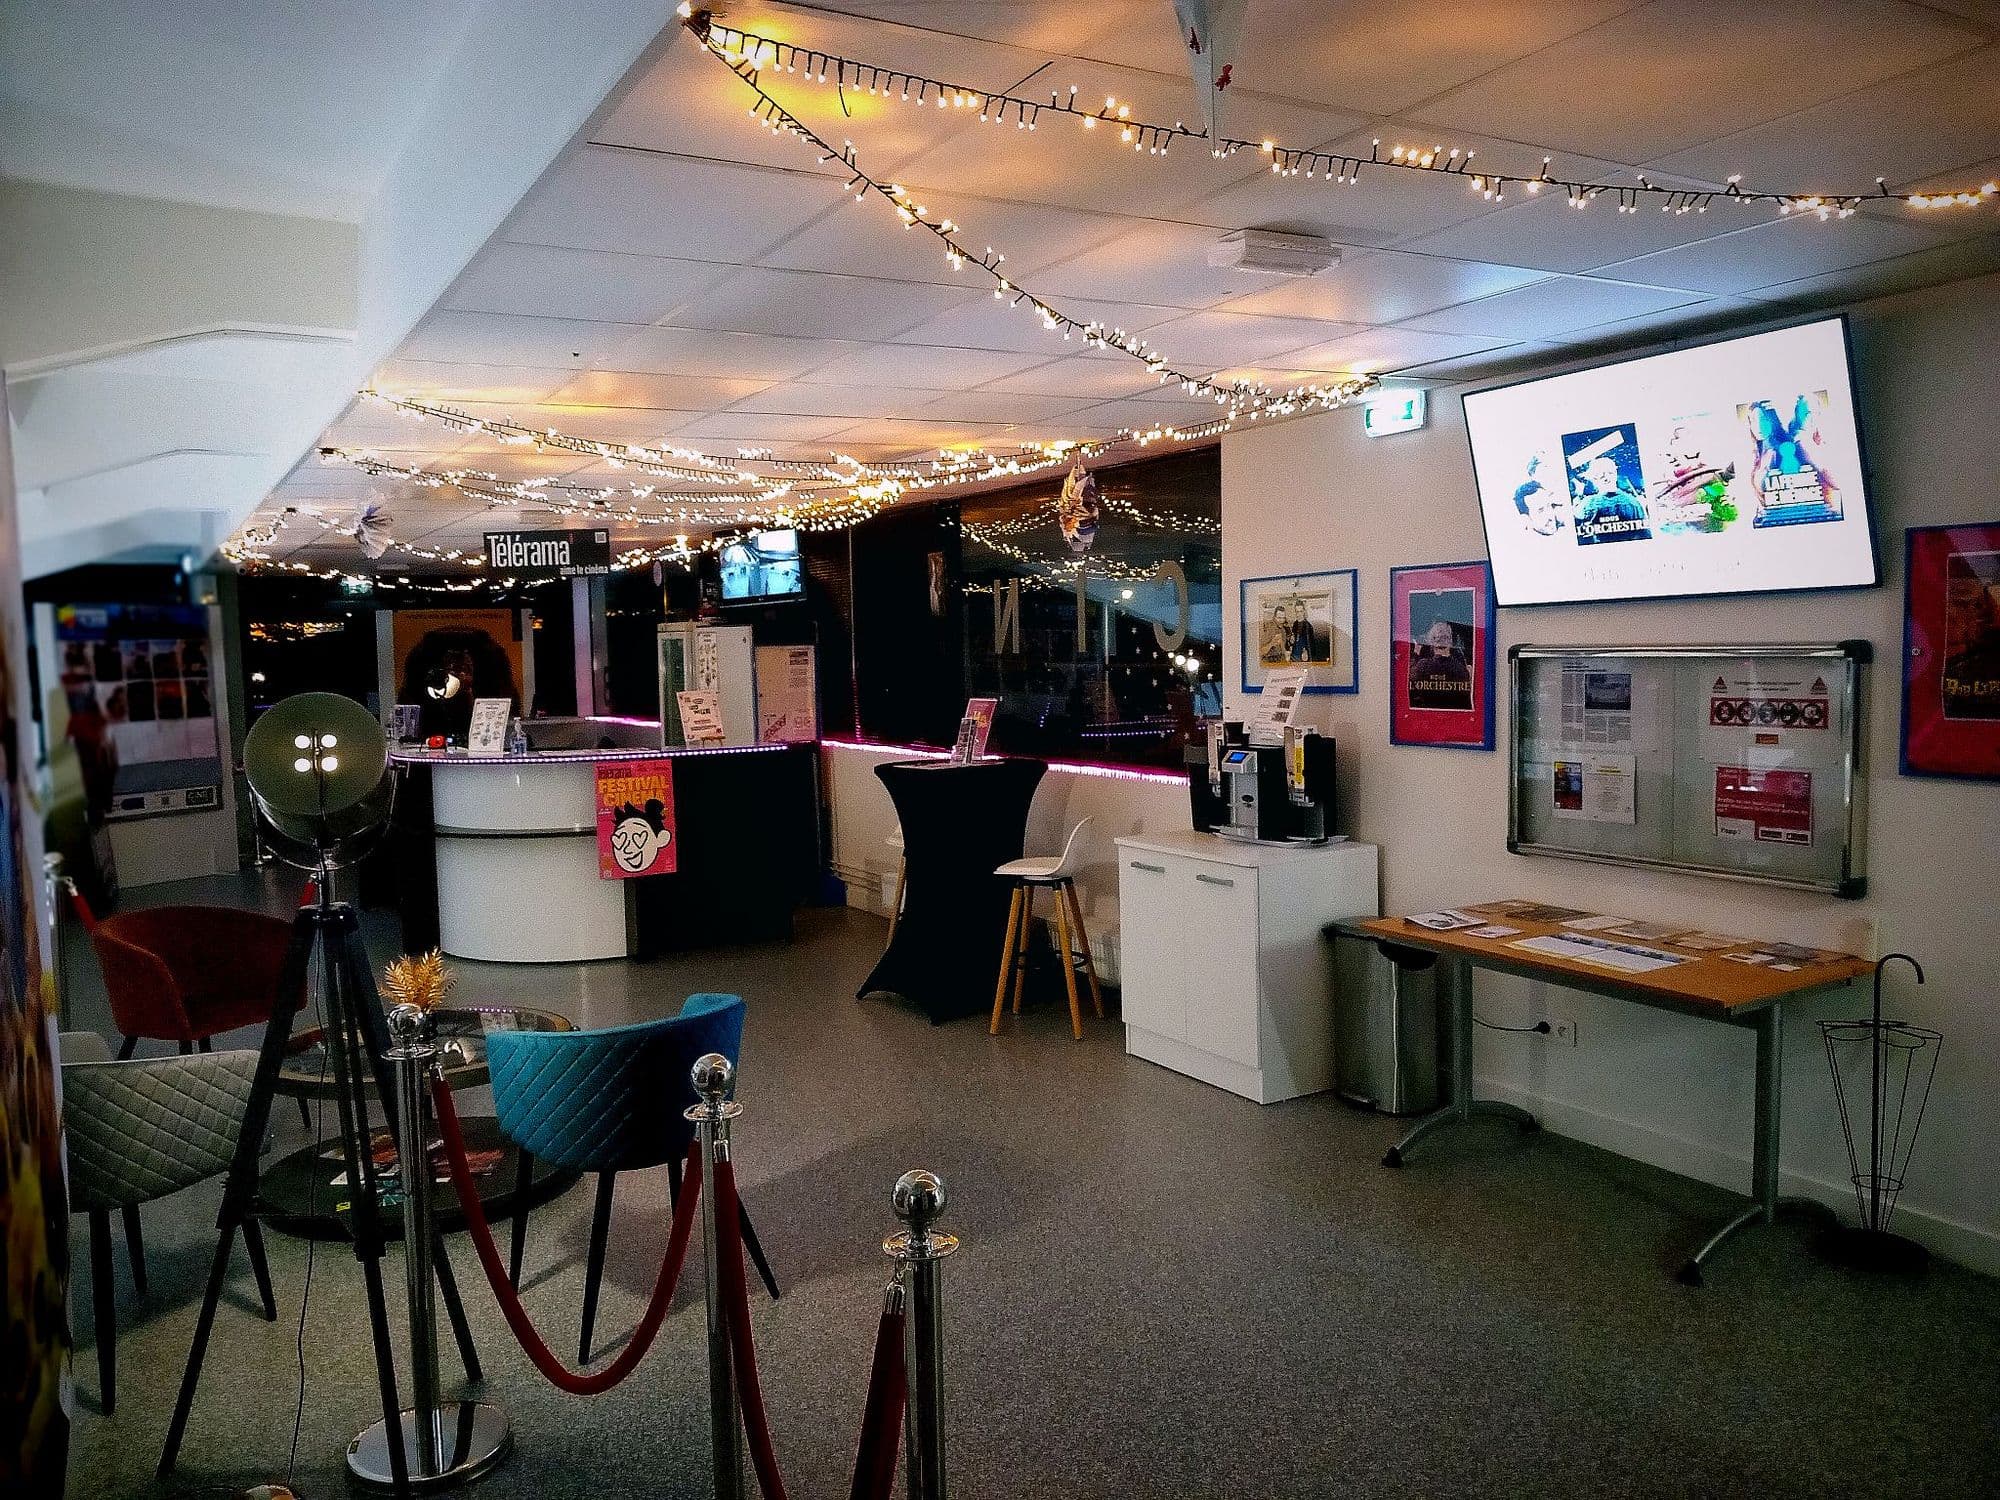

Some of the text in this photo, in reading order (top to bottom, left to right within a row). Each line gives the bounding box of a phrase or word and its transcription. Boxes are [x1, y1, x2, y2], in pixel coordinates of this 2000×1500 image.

[487, 534, 570, 567] Télérama
[1409, 680, 1472, 692] L'ORCHESTRE
[597, 774, 670, 794] FESTIVAL
